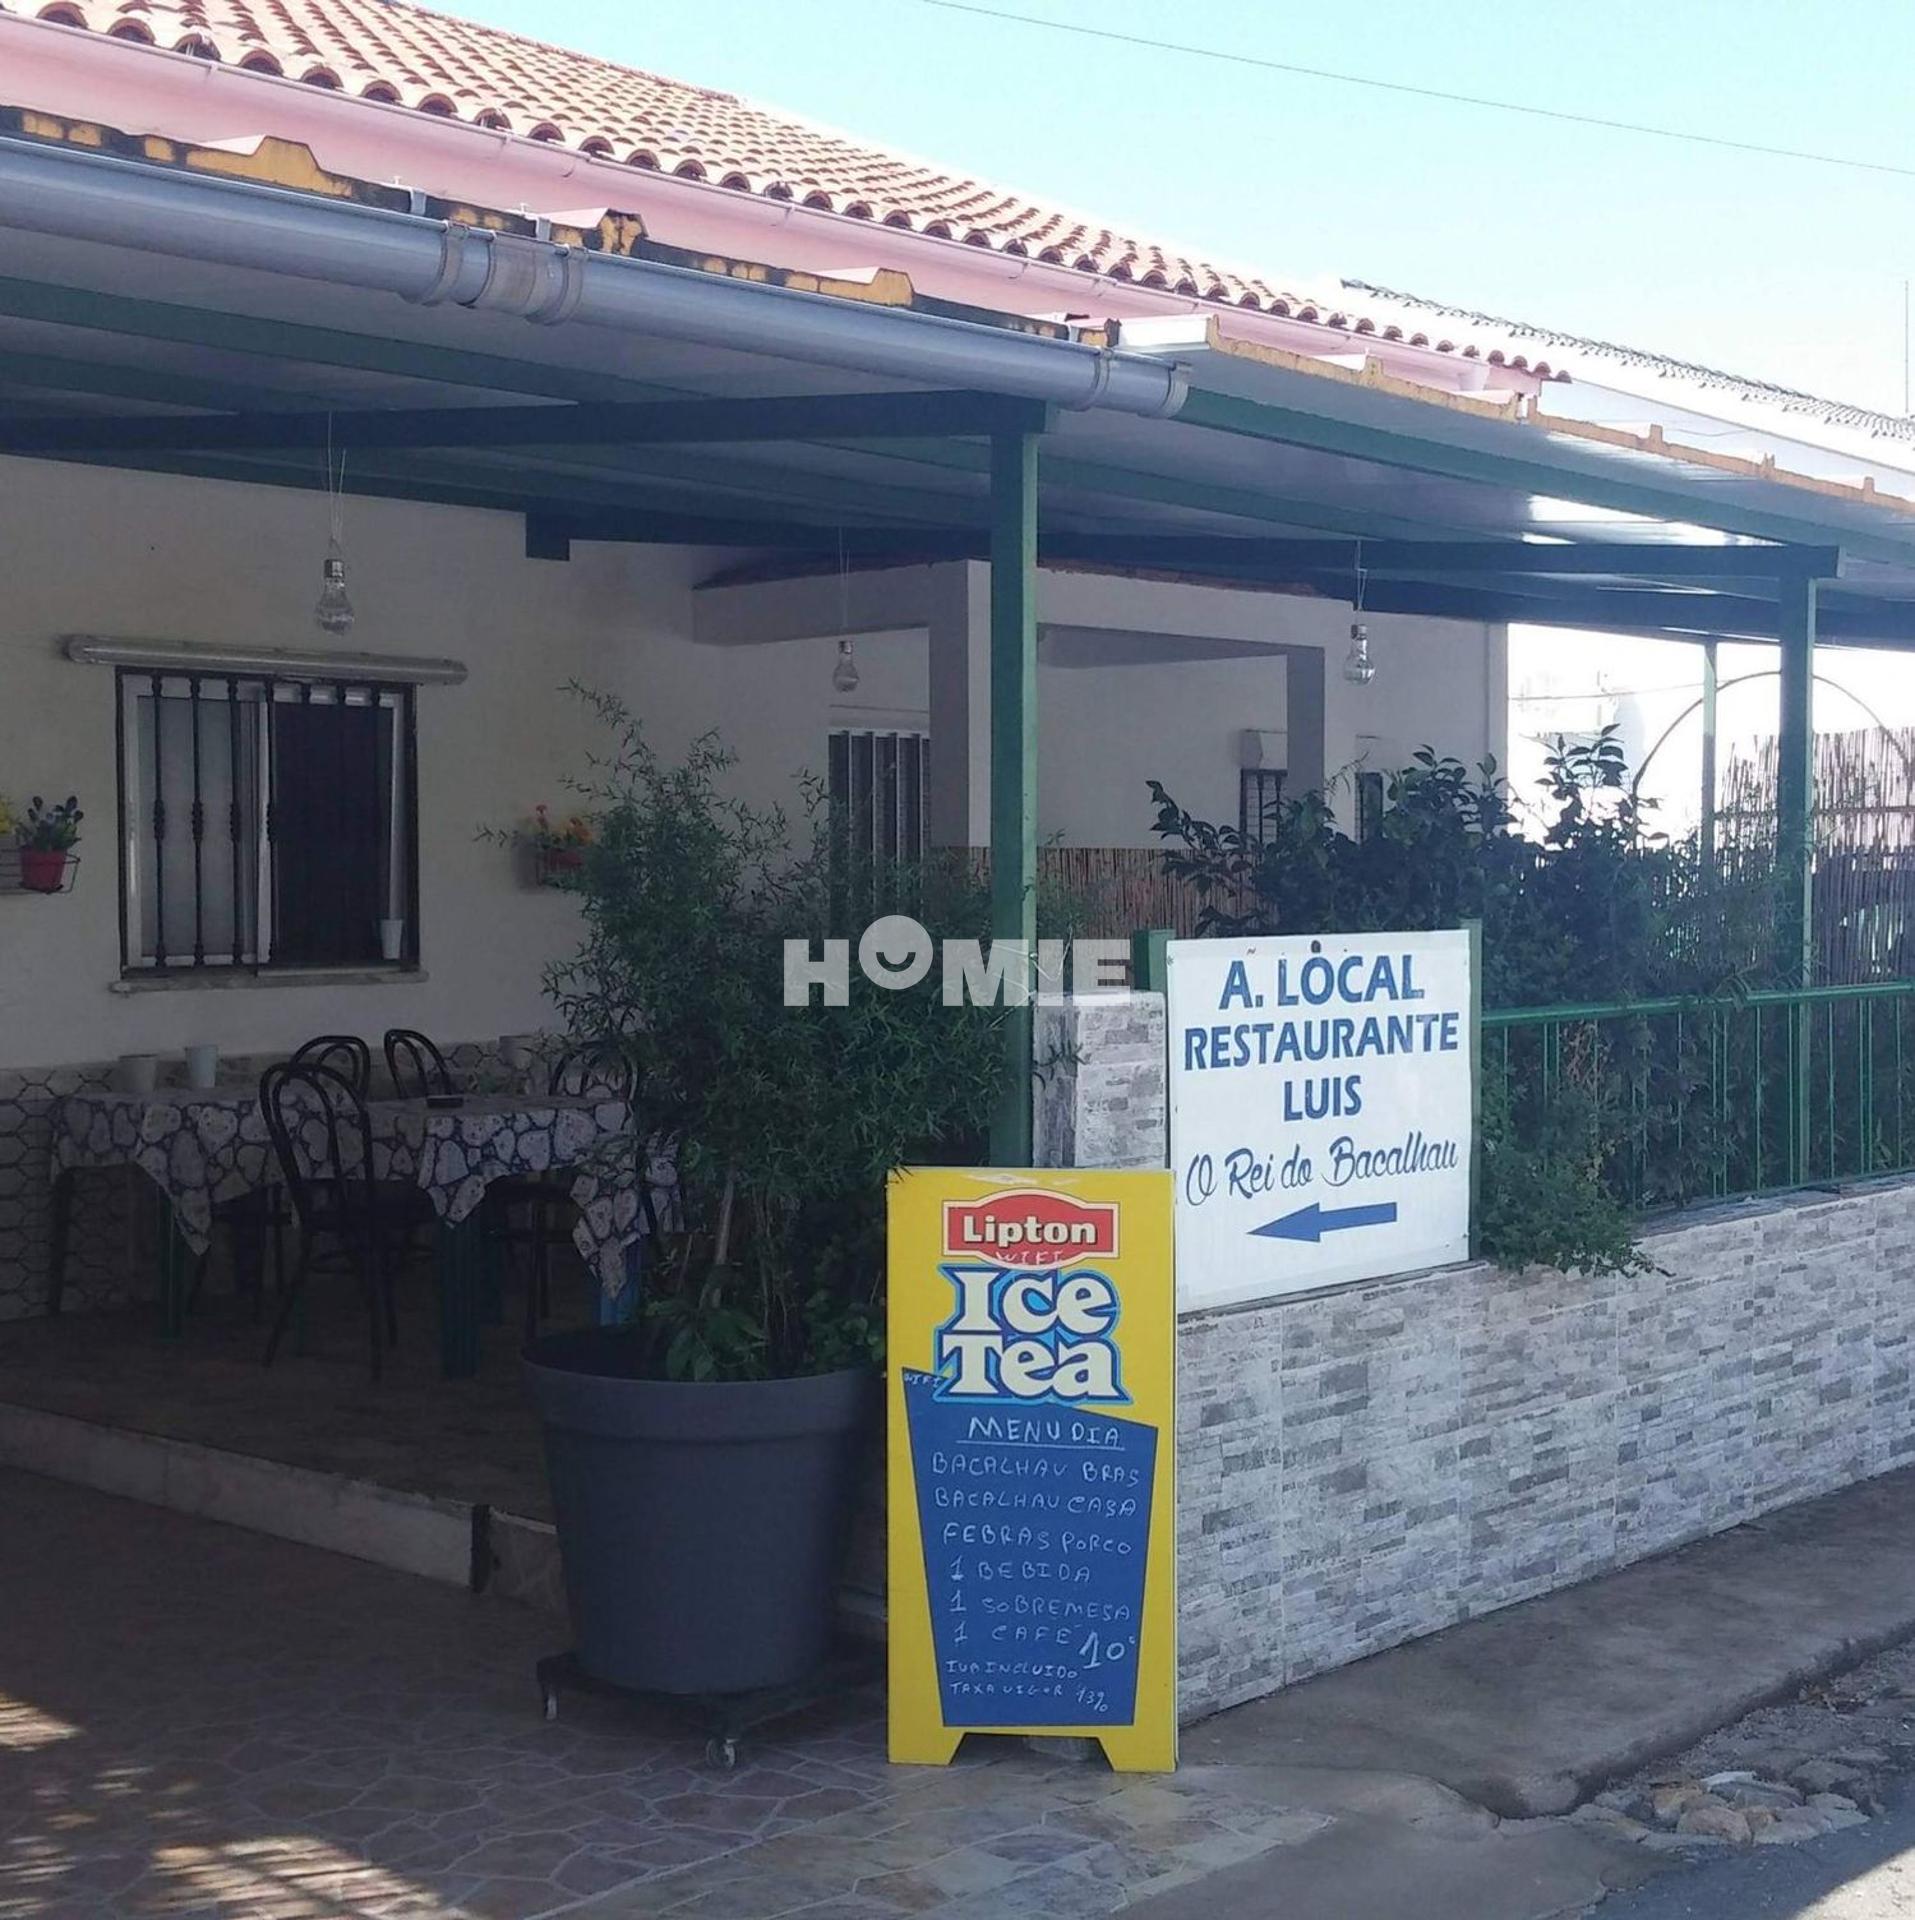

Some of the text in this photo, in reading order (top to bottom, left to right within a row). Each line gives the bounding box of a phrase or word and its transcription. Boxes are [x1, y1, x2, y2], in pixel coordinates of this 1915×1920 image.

[1219, 954, 1425, 1010] A. LOCAL
[1184, 1012, 1460, 1071] RESTAURANTE
[1283, 1075, 1363, 1122] LUIS
[1186, 1131, 1459, 1206] O Rei do Bacalhau
[962, 1215, 1097, 1248] Lipton
[951, 1271, 1112, 1335] Ice
[943, 1334, 1121, 1398] Tea
[967, 1416, 1119, 1448] MENU DIA
[932, 1451, 1140, 1488] BACALHAU BRAS
[935, 1487, 1137, 1518] BACALHAU CASA
[943, 1522, 1051, 1550] FEBRAS
[949, 1554, 1091, 1583] 1 BEBIDA
[949, 1589, 1131, 1622] 1 SOBREMESA
[953, 1621, 969, 1648] 1
[949, 1681, 996, 1696] TAXA
